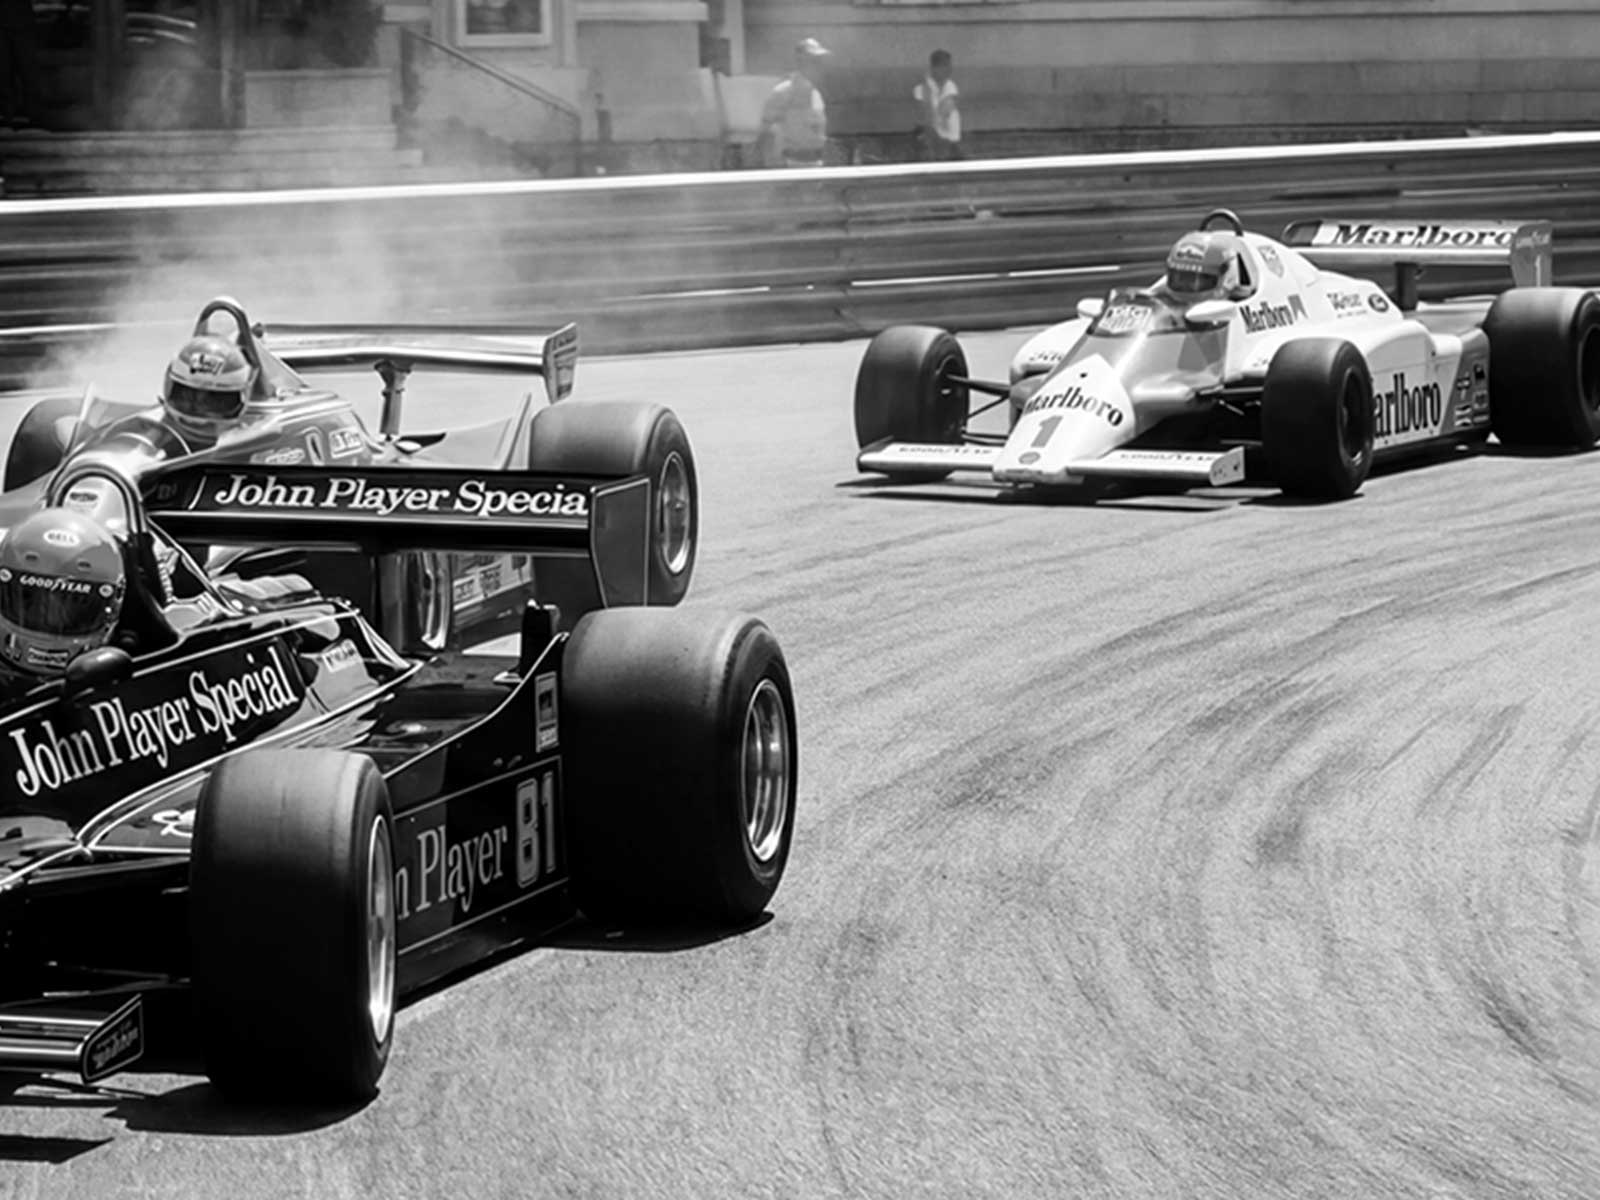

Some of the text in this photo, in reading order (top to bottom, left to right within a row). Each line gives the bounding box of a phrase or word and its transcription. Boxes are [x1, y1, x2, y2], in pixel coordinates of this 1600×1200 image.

[1332, 224, 1512, 246] Marlboro
[1239, 300, 1294, 334] Marlboro
[1373, 372, 1442, 438] arlboro
[1030, 415, 1063, 448] 1
[215, 475, 317, 508] John
[320, 478, 450, 516] Player
[453, 480, 596, 518] Specia
[19, 574, 92, 594] GOODYEAR
[9, 645, 299, 796] John Player Special
[416, 824, 508, 913] Player
[516, 771, 556, 889] 81
